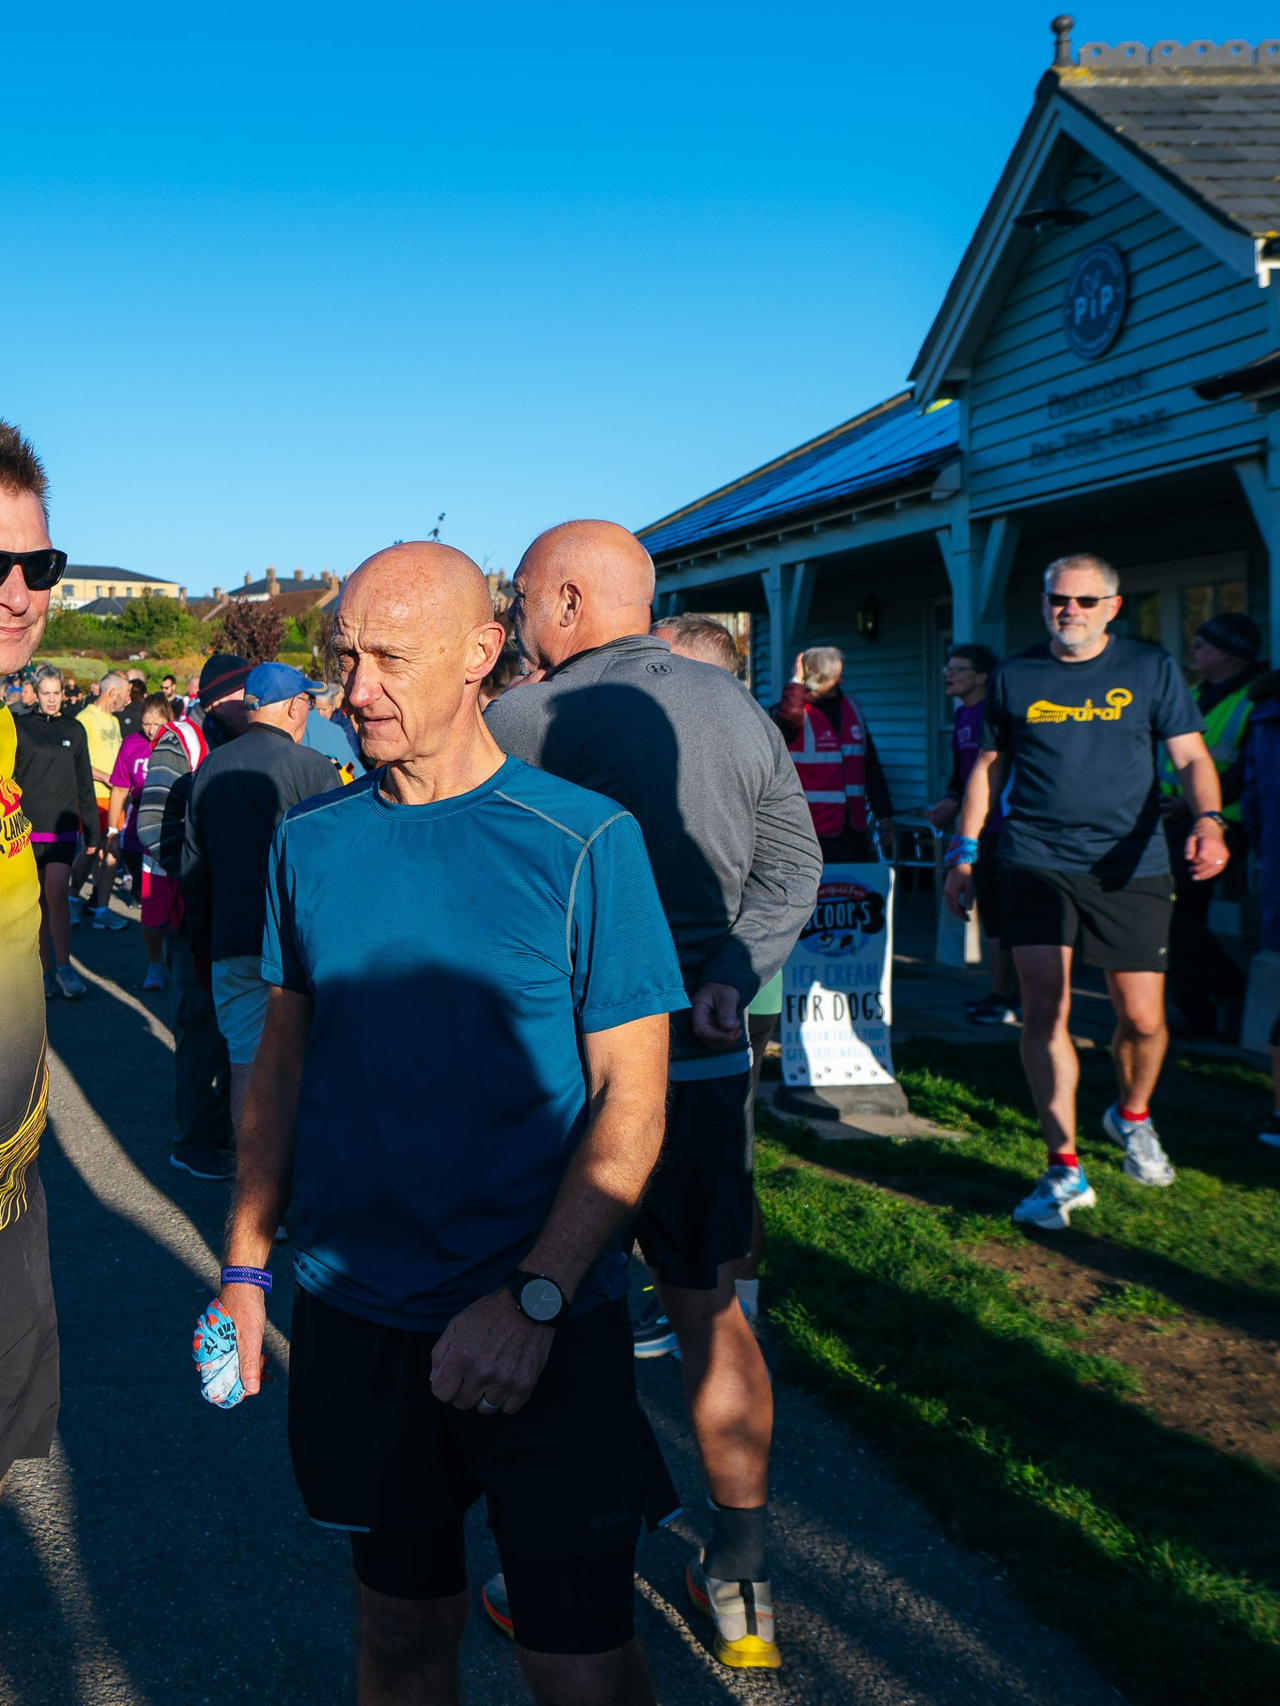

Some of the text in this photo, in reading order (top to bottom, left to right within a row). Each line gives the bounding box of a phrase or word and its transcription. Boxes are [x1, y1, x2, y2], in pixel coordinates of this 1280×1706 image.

[792, 962, 879, 989] ICE CREAM
[786, 991, 886, 1023] FOR DOGS
